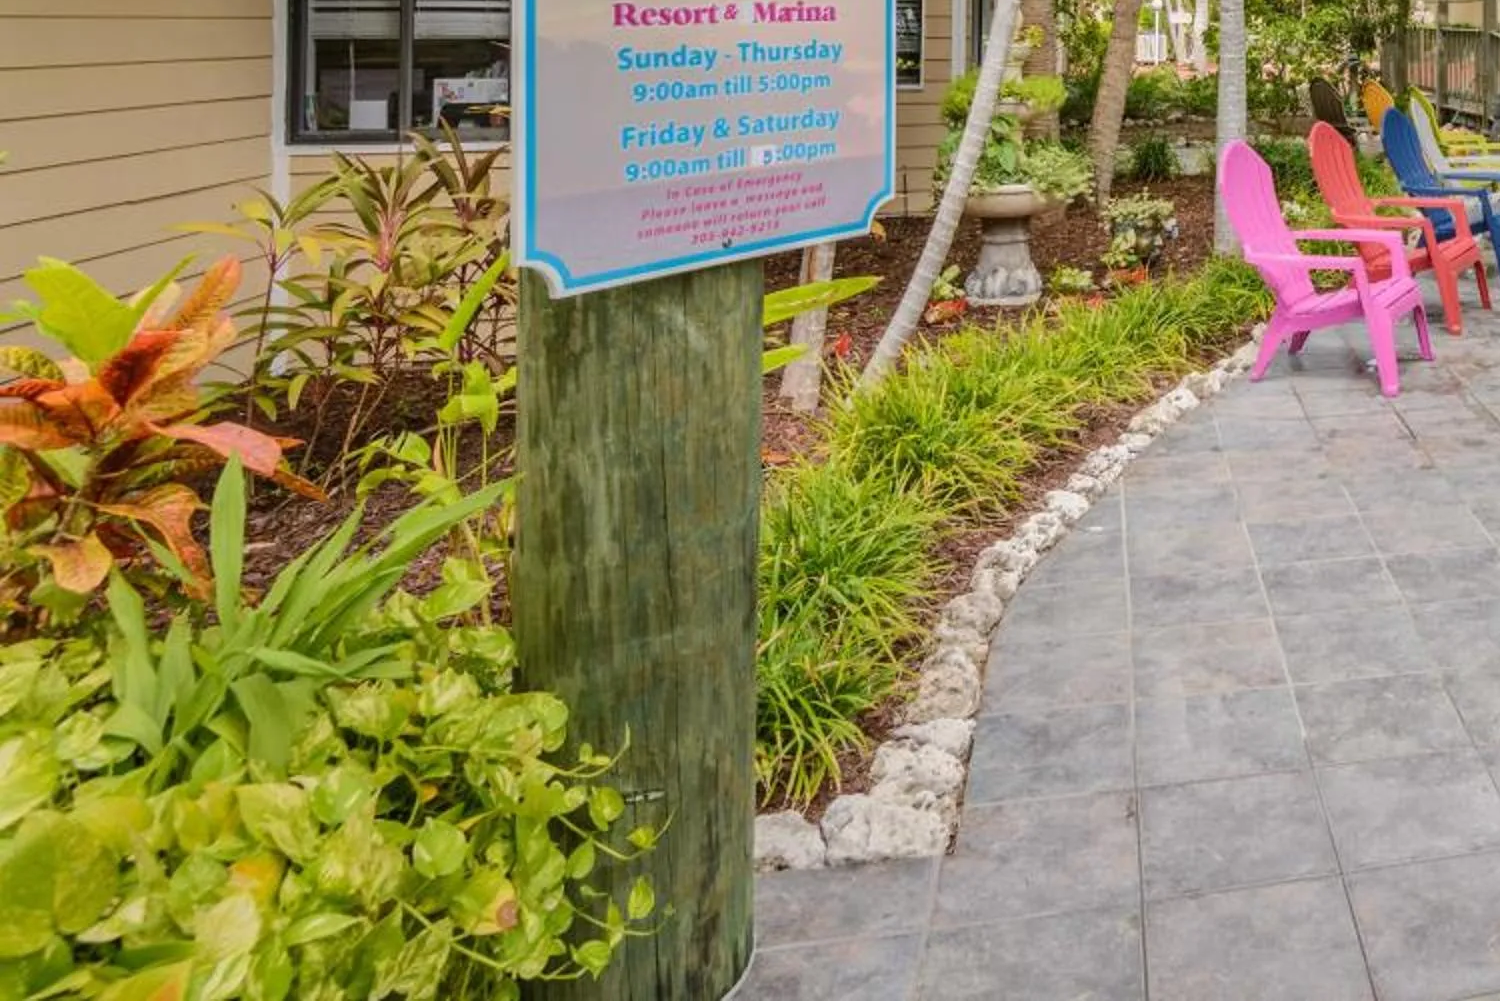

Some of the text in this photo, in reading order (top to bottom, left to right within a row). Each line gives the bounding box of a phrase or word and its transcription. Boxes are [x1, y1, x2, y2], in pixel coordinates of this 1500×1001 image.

[612, 1, 836, 26] Resort & Marina
[617, 45, 716, 71] Sunday
[737, 40, 842, 62] Thursday
[633, 73, 831, 102] 9:00am till 5:00pm
[621, 109, 839, 149] Friday & Saturday
[625, 159, 709, 182] 9:00am
[717, 148, 744, 167] till
